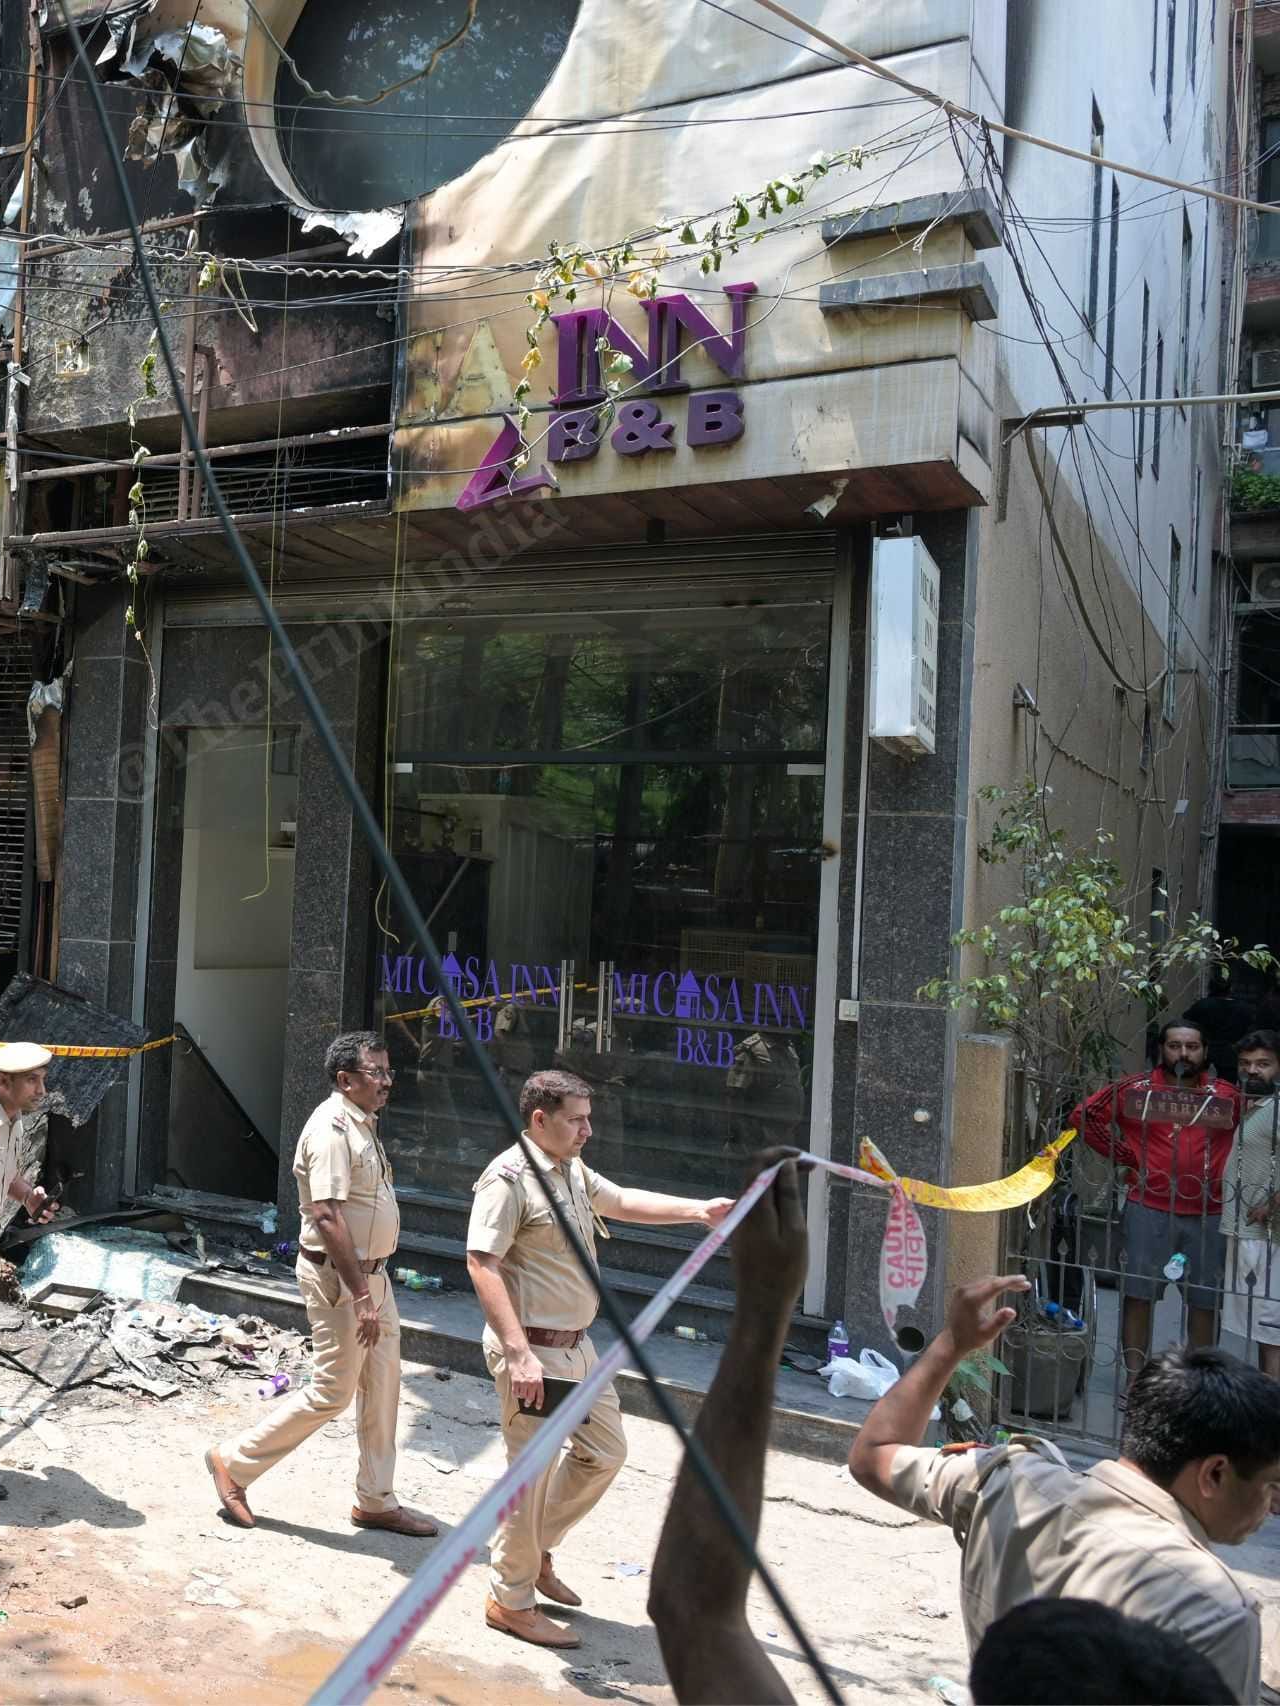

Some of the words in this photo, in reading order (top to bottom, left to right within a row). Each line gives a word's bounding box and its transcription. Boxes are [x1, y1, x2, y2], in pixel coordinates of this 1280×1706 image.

[549, 281, 758, 407] INN
[378, 953, 415, 994] MI
[417, 952, 502, 1002] CSA
[509, 963, 561, 1008] INN
[612, 972, 648, 1015] MI
[652, 969, 745, 1024] CSA
[752, 982, 809, 1030] INN
[675, 1027, 735, 1069] B&B
[885, 1192, 906, 1289] CAUTI
